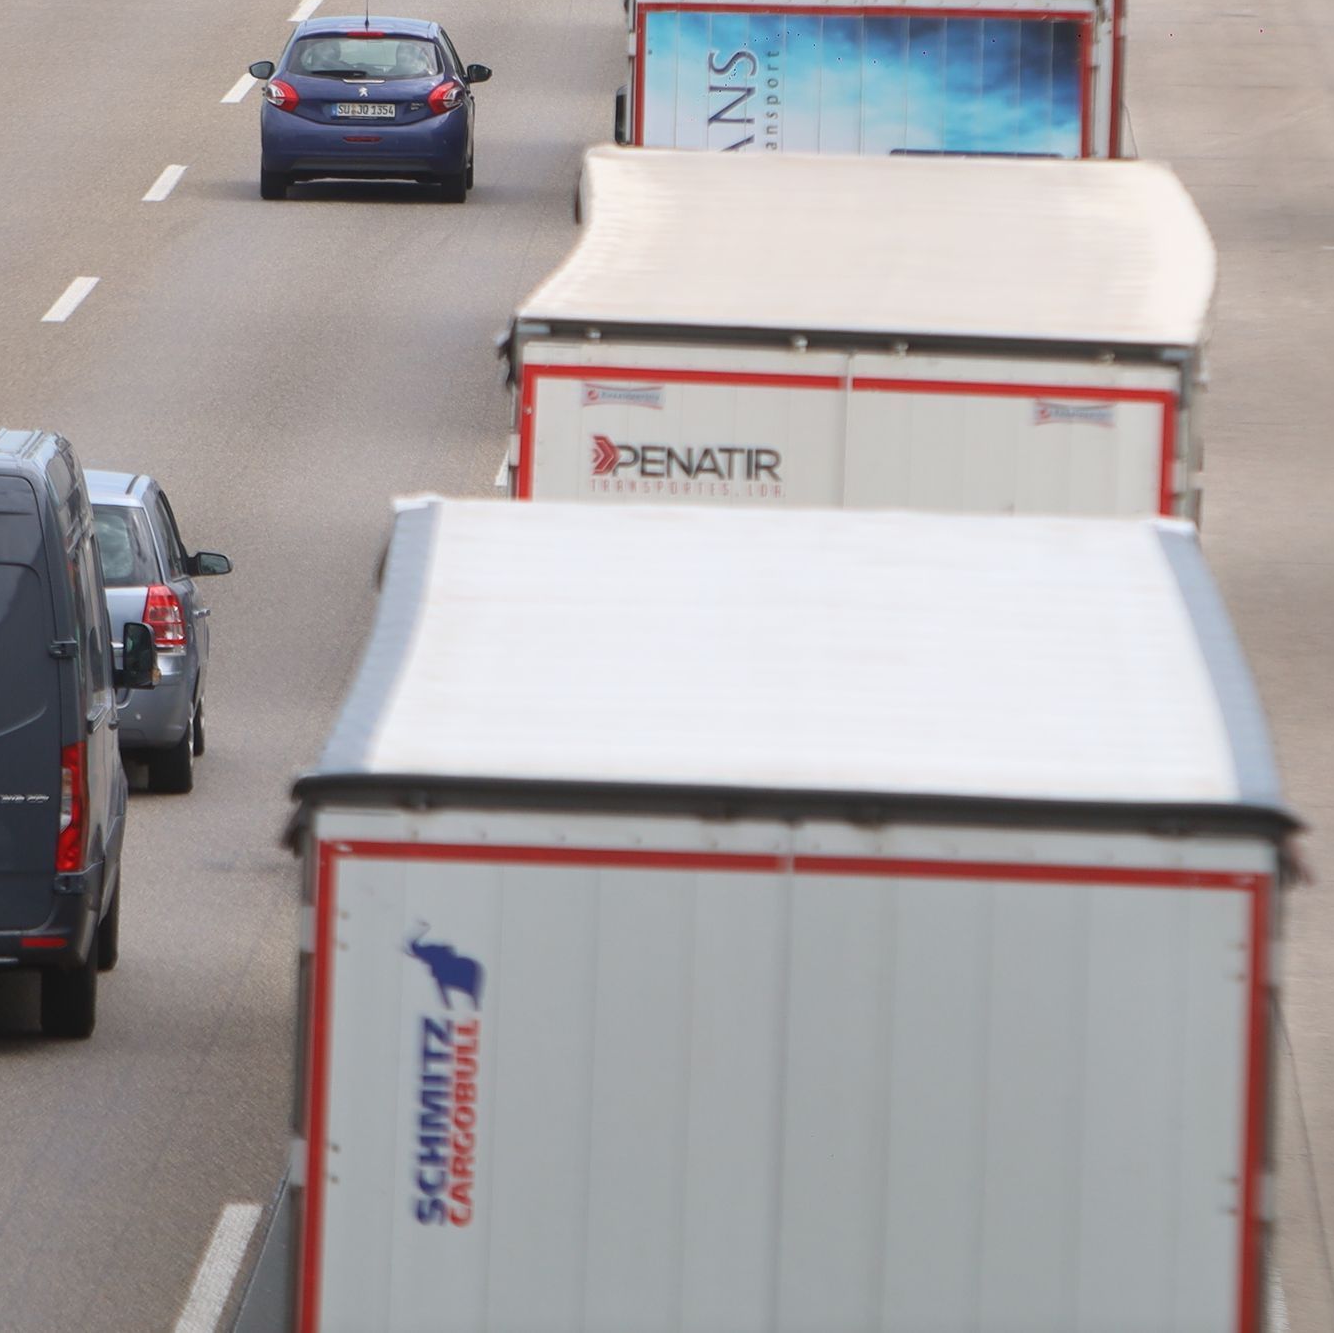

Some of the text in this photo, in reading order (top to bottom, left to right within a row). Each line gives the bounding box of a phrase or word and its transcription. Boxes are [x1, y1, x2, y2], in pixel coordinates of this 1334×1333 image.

[338, 104, 350, 115] SU
[371, 105, 395, 116] 1354
[612, 444, 782, 481] PENATIR
[417, 1017, 454, 1226] SCHMITZ
[448, 1018, 481, 1228] CARGOBULL
